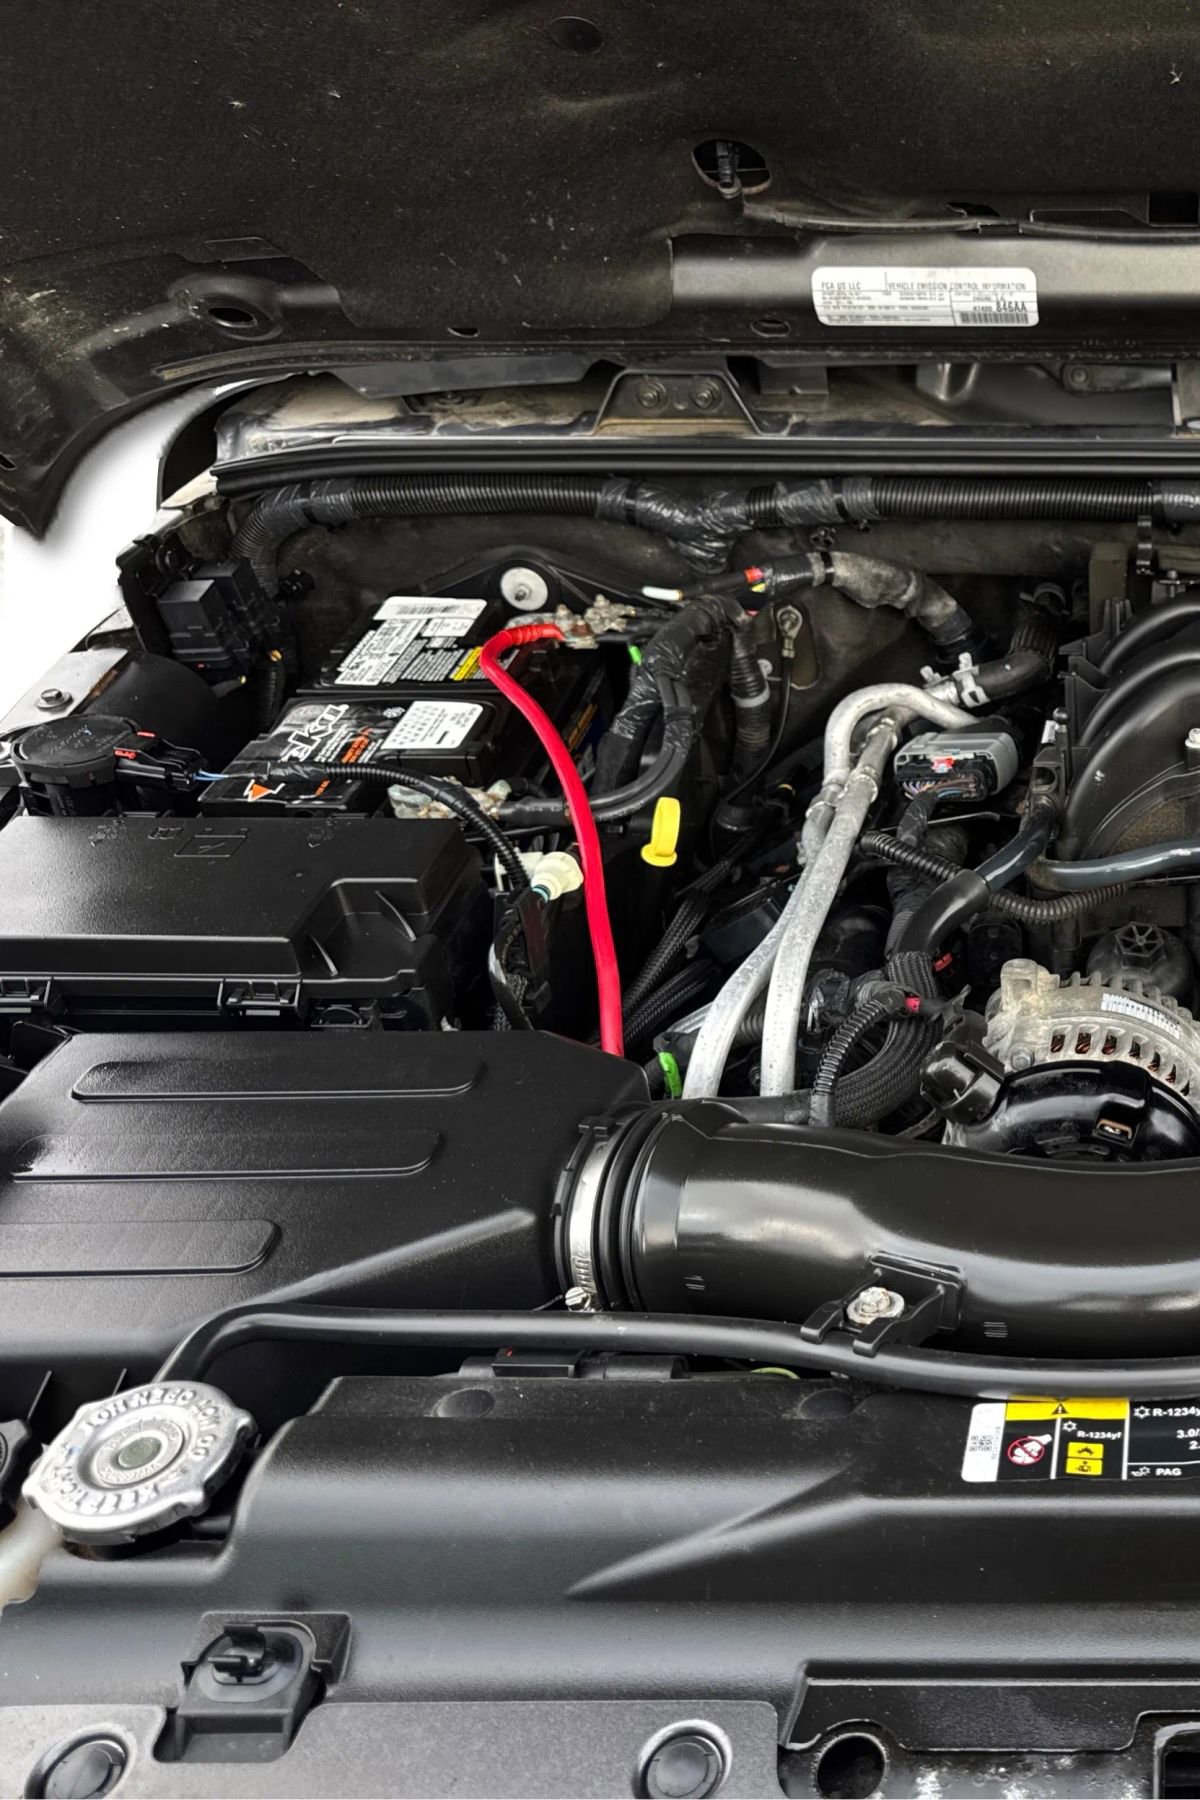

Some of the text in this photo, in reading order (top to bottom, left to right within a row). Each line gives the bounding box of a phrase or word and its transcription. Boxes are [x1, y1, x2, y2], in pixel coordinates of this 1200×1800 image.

[821, 282, 835, 290] FCA
[848, 282, 861, 290] LLC
[888, 282, 1026, 291] VEHICLE EMISSION CONTROL INFORMATION
[1077, 1430, 1122, 1440] R-1234yf
[1155, 1468, 1182, 1476] PAG
